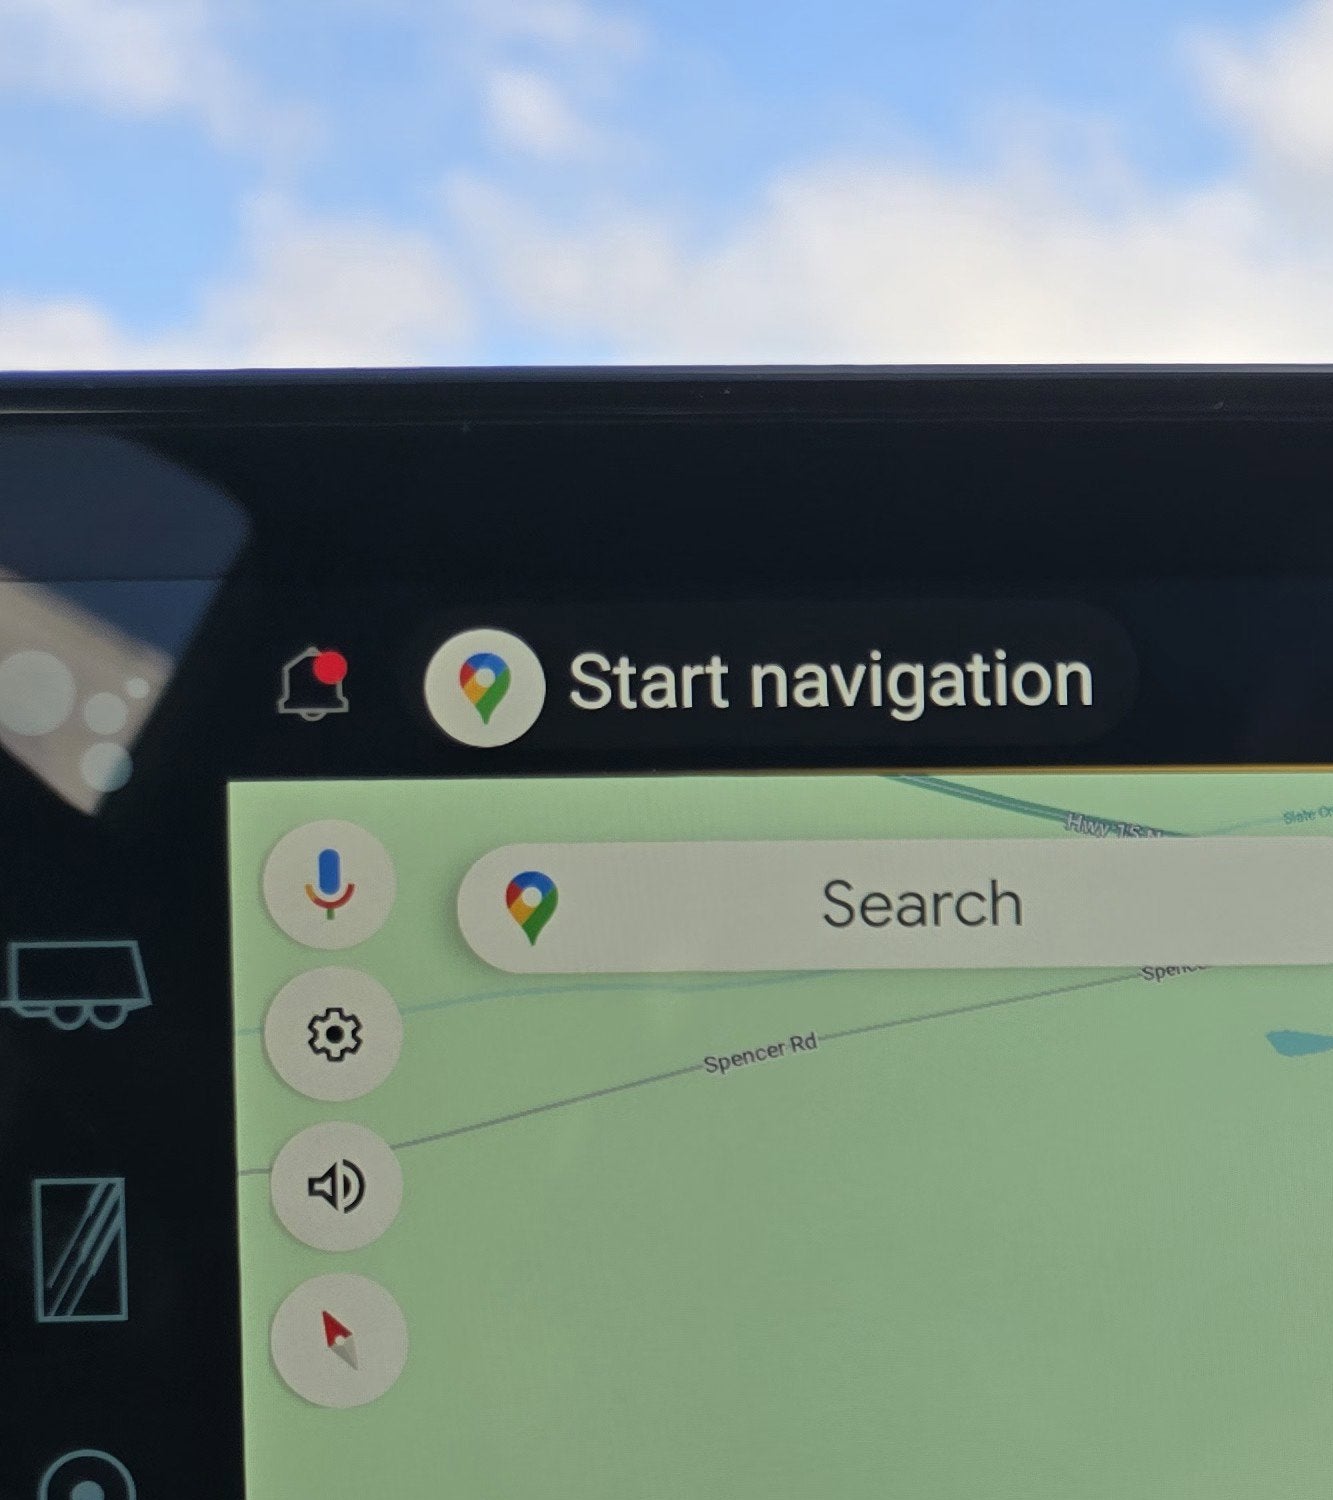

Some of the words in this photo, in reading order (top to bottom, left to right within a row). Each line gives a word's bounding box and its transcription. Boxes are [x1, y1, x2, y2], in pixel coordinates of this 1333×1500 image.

[569, 651, 730, 711] Start
[751, 649, 1094, 721] navigation
[822, 879, 1024, 928] Search
[703, 1042, 786, 1075] Spencer
[788, 1031, 819, 1053] Rd
